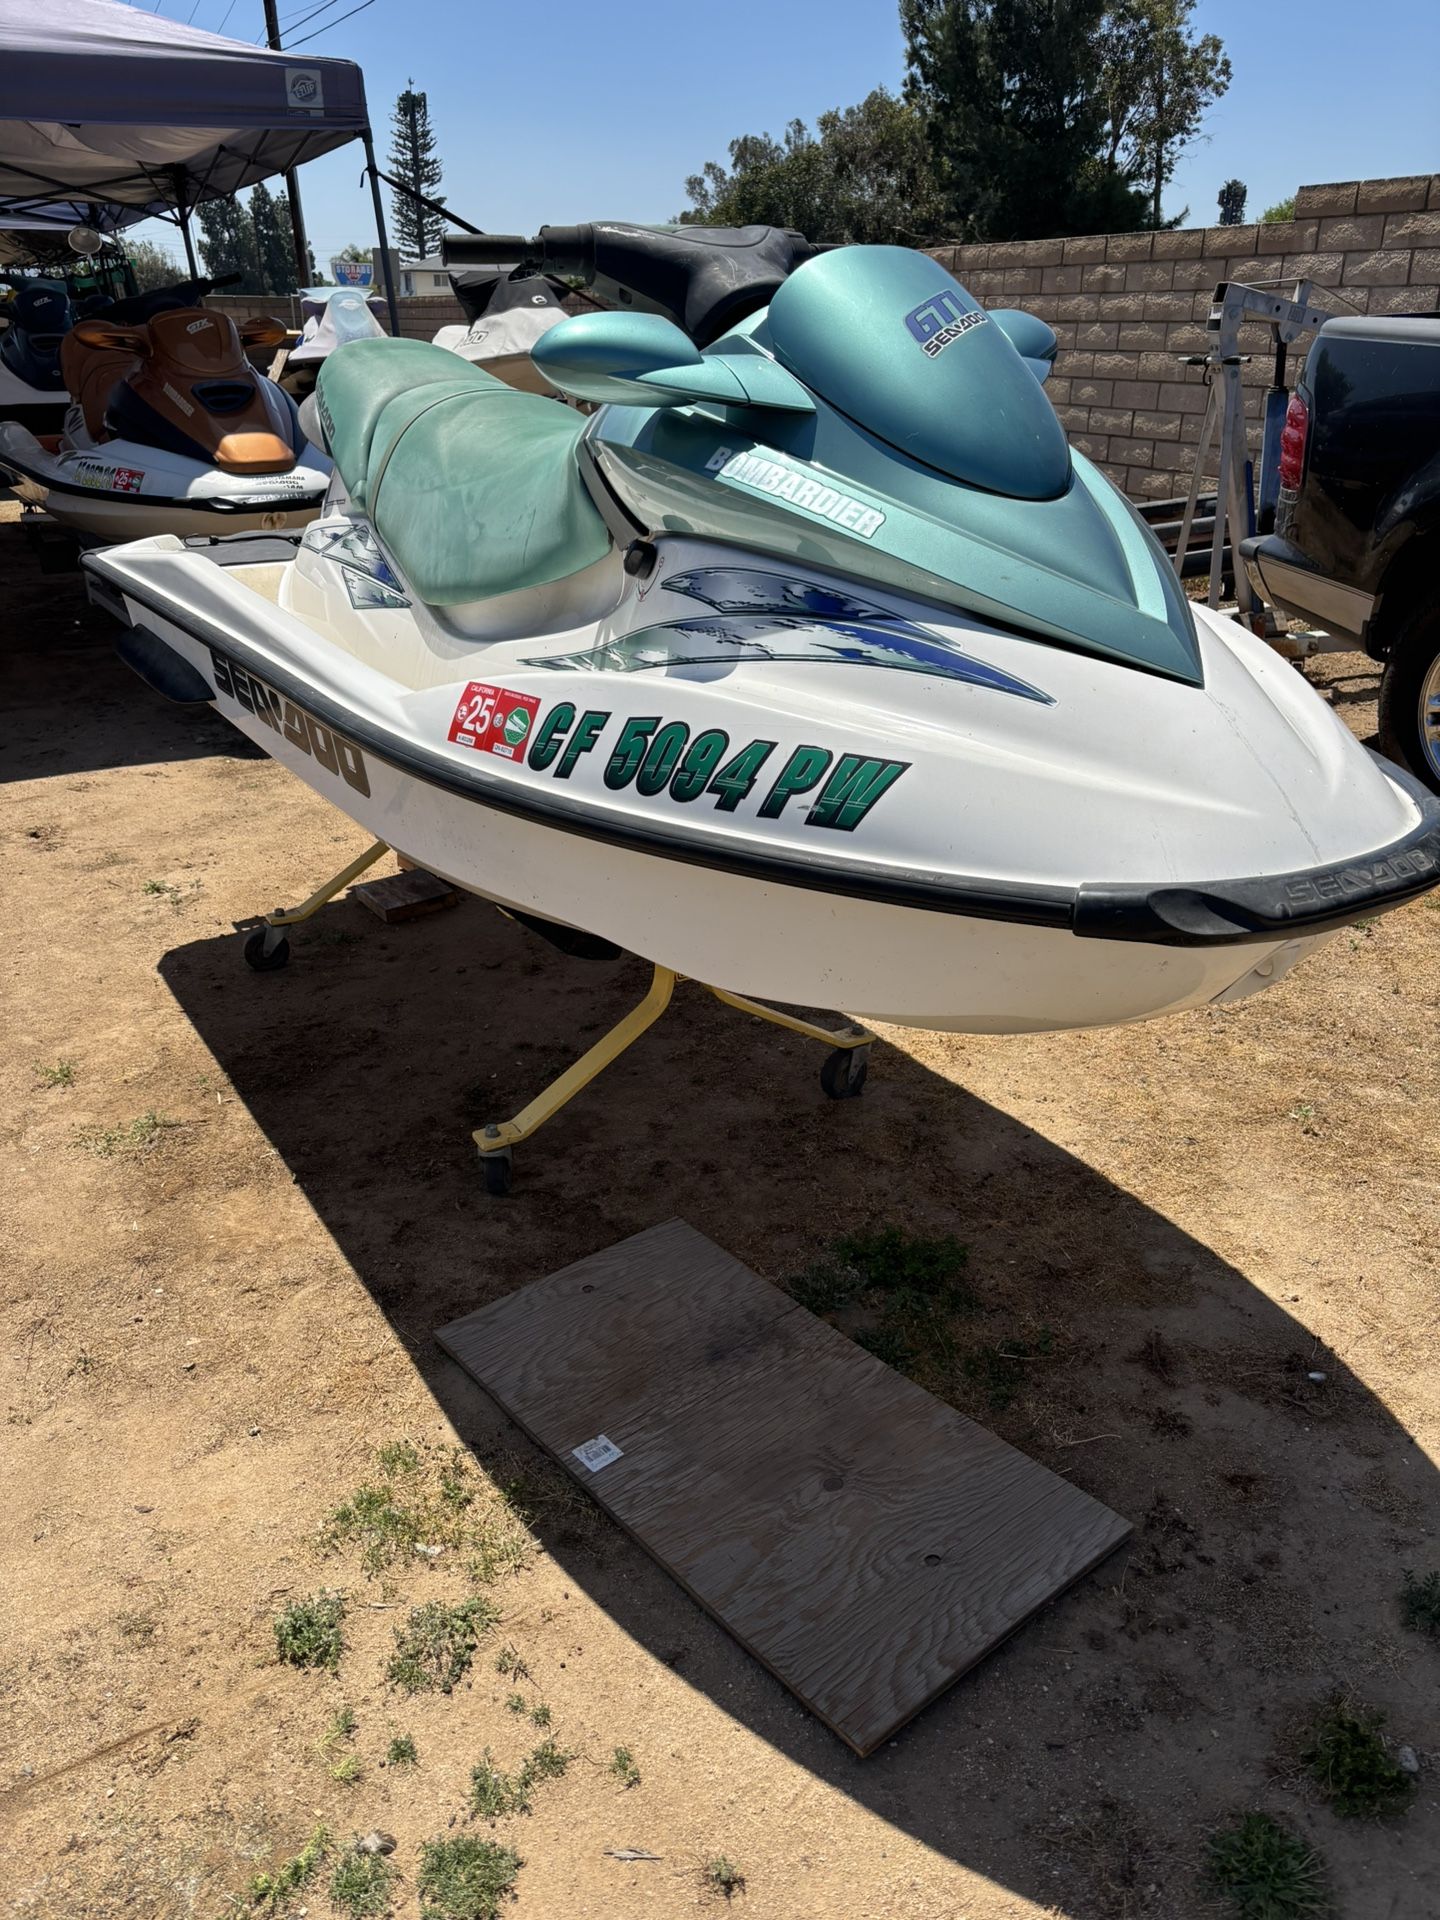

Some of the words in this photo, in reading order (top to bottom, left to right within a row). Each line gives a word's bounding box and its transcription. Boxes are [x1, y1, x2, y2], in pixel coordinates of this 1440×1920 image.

[905, 289, 968, 343] GTI
[704, 446, 885, 538] BOMBARDIER
[462, 695, 496, 734] 25
[526, 701, 612, 779] CF
[603, 716, 779, 812] 5094
[756, 745, 913, 832] PW
